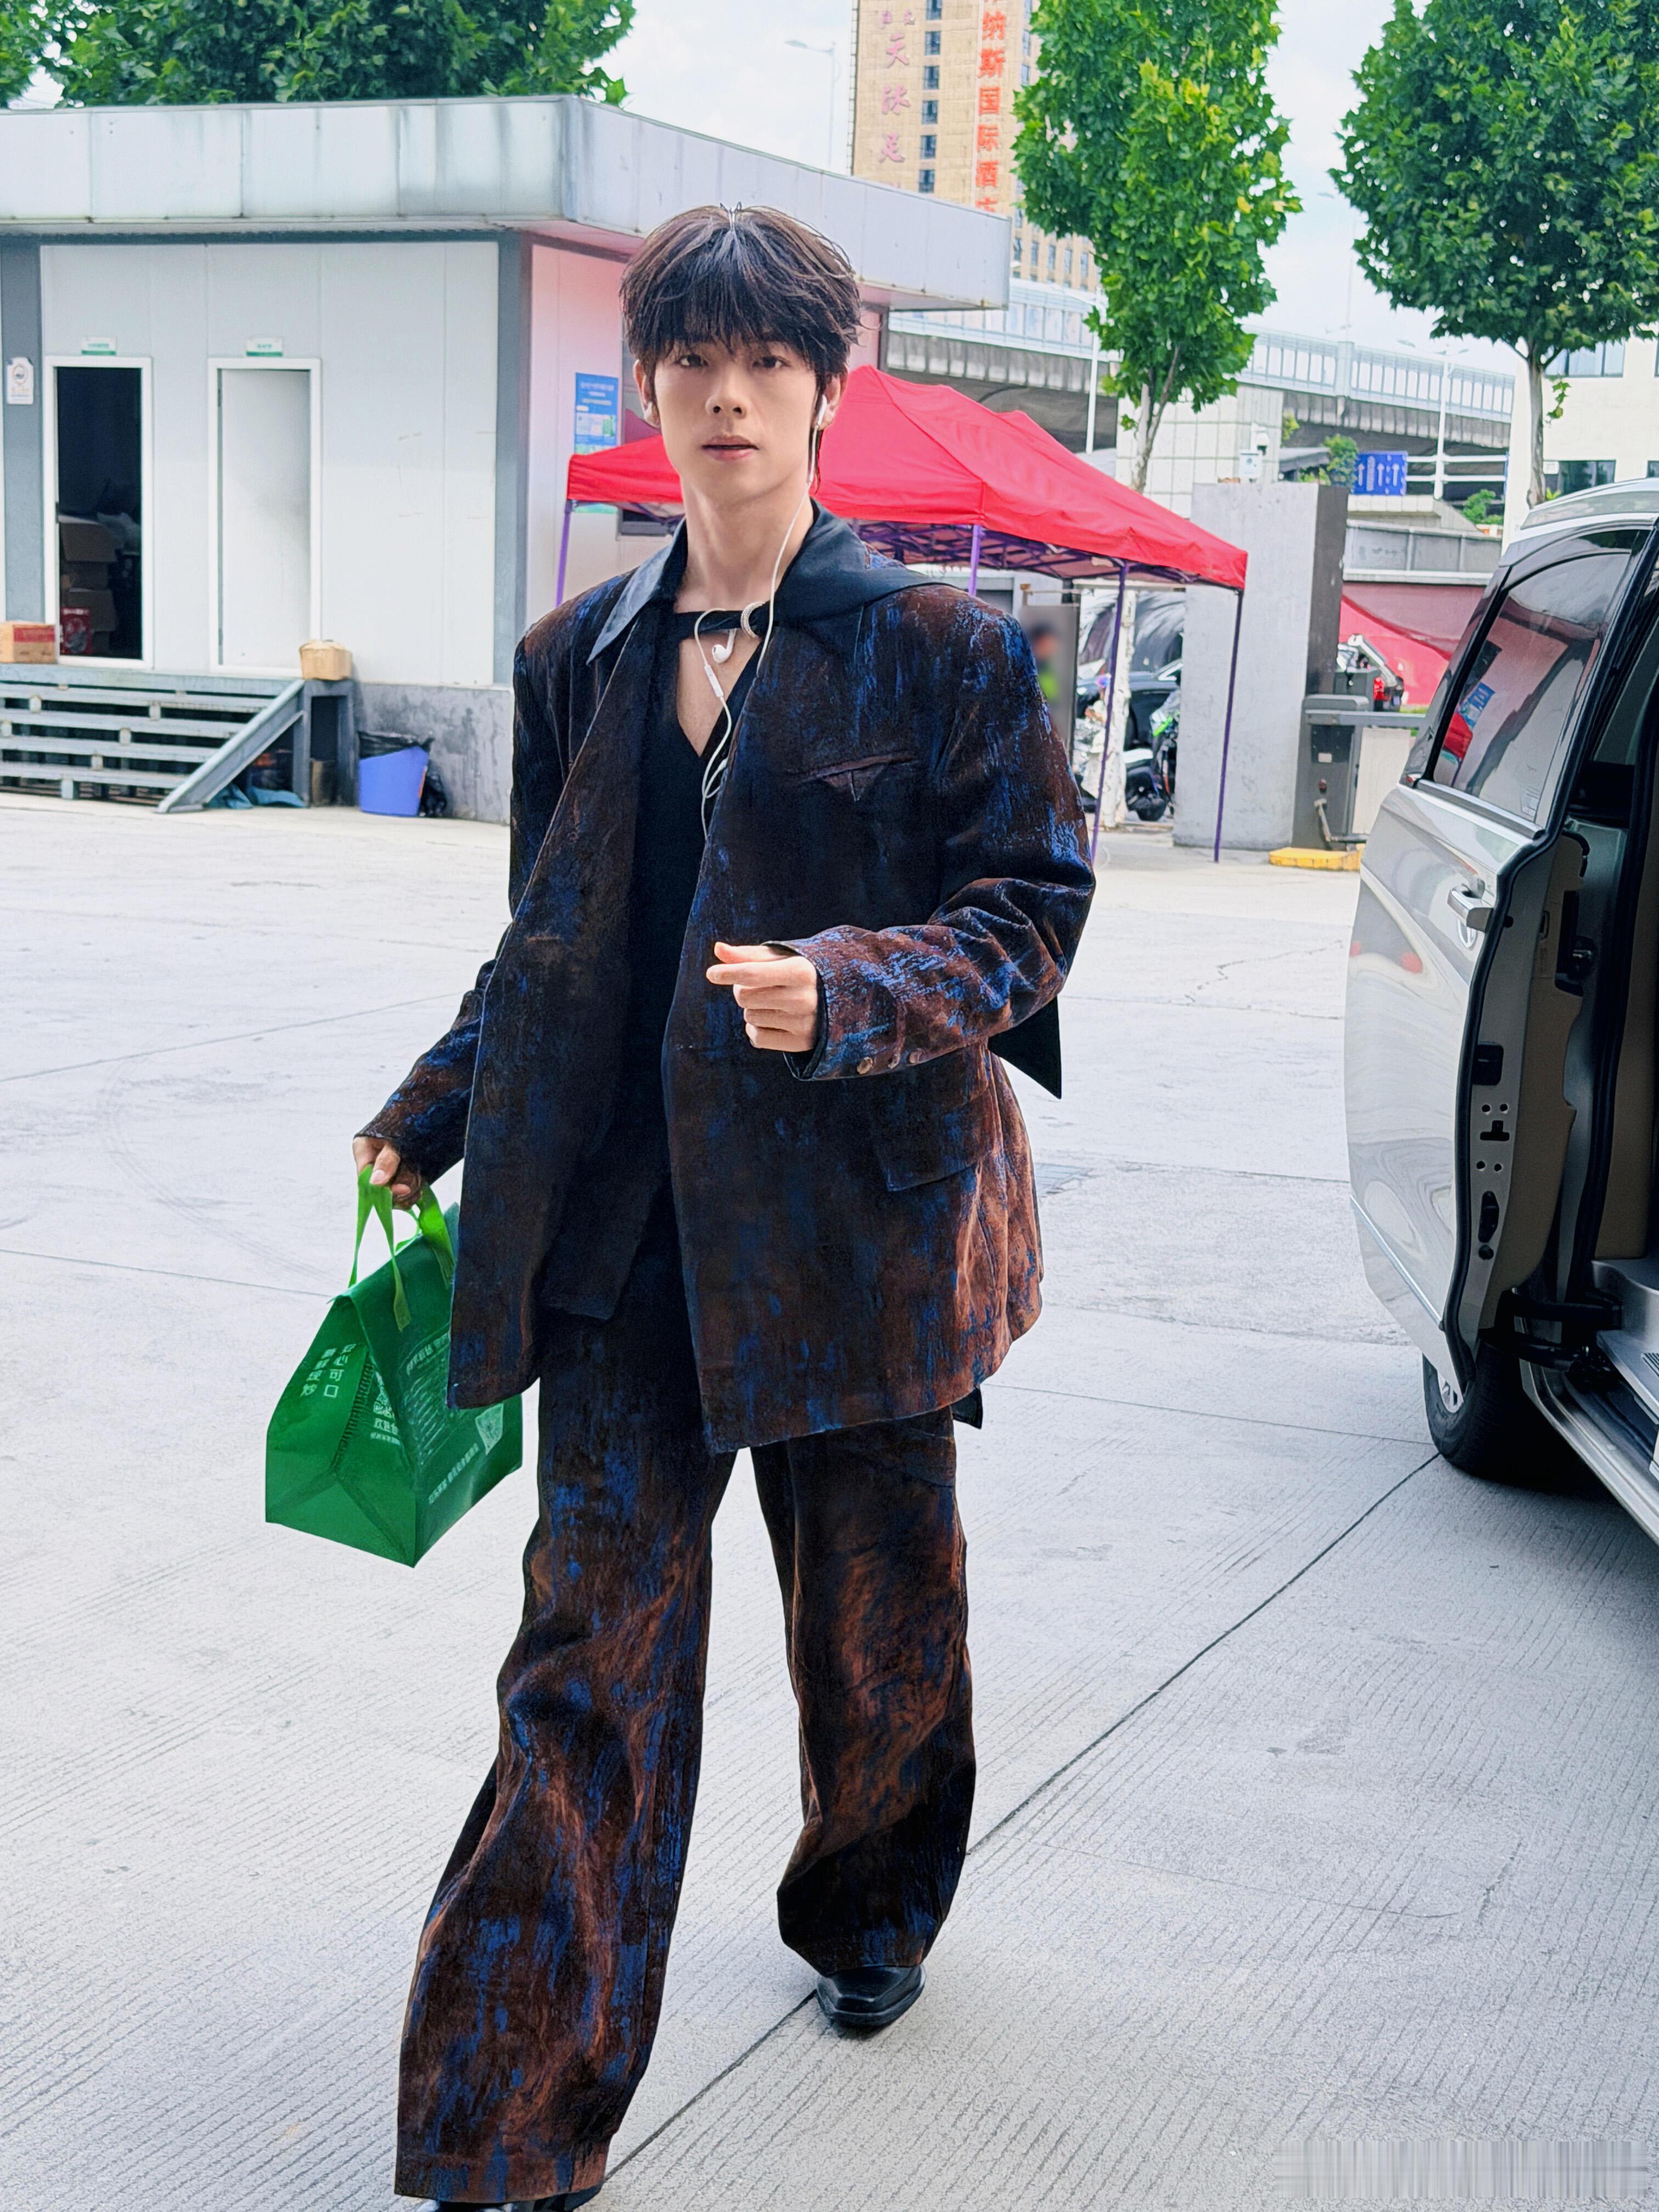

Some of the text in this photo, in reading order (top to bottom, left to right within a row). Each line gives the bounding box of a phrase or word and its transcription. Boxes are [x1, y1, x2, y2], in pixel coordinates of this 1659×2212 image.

[878, 32, 910, 188] 天沐足
[975, 0, 1007, 212] 纳斯国际酒
